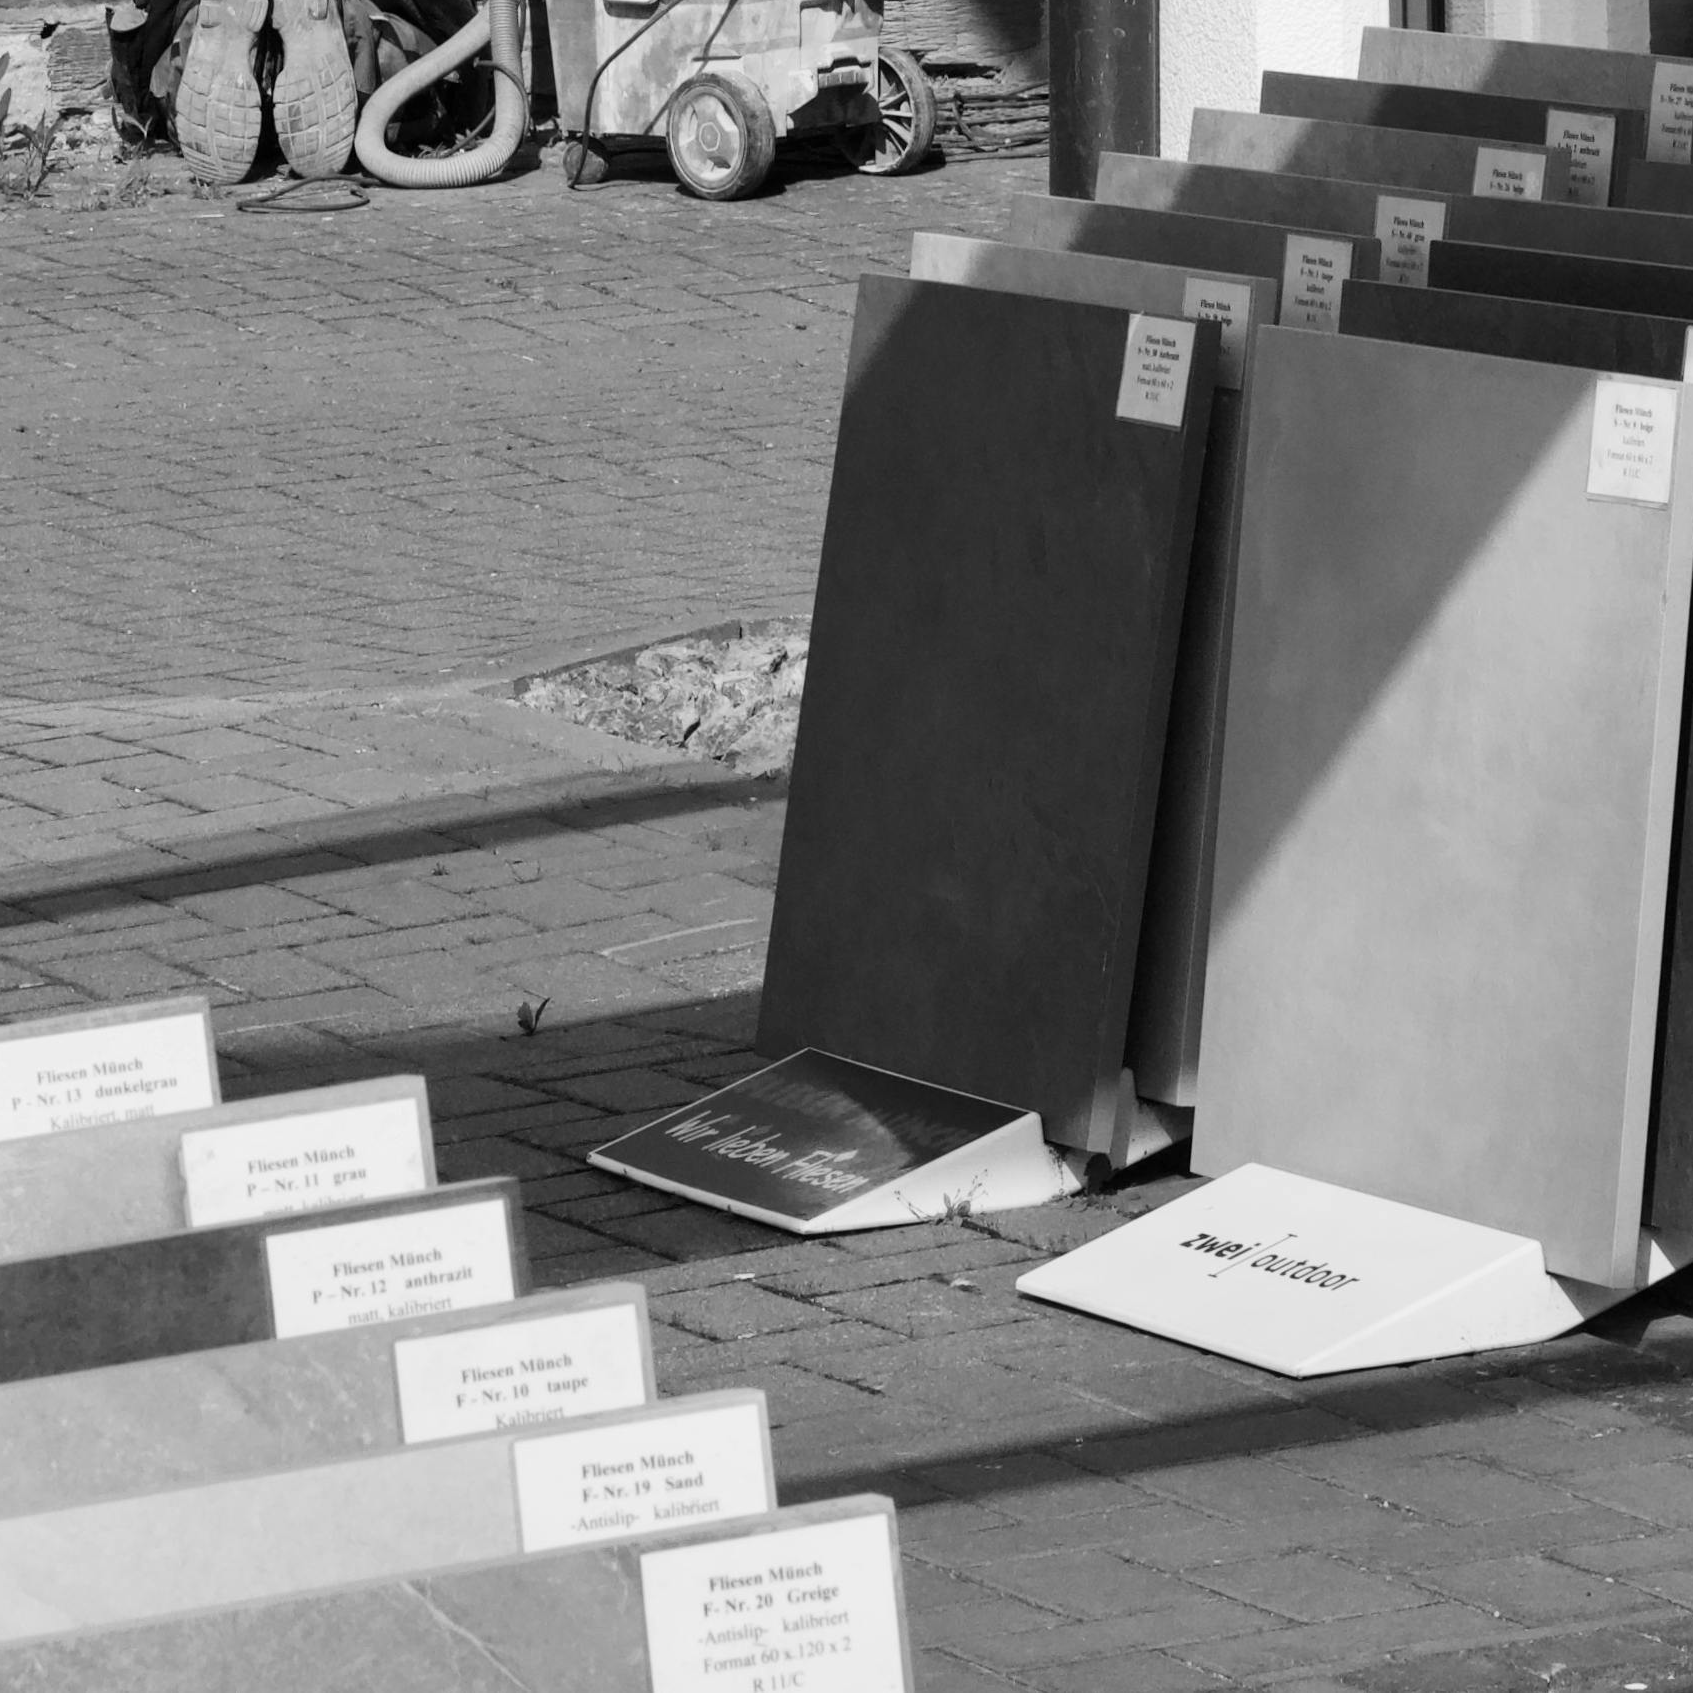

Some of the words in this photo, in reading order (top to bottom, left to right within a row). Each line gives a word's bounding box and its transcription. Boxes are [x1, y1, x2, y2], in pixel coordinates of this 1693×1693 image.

[36, 1069, 87, 1085] Fliesen
[93, 1057, 143, 1077] Münch
[12, 1097, 21, 1111] P
[37, 1093, 60, 1107] Nr.
[67, 1088, 82, 1102] 13
[95, 1077, 178, 1099] dunkelgrau
[247, 1156, 299, 1174] Fliesen
[304, 1145, 355, 1165] Münch
[701, 1125, 790, 1166] lieben
[771, 1149, 869, 1194] Fliesen
[247, 1183, 257, 1197] P
[274, 1178, 299, 1192] Nr.
[305, 1173, 319, 1187] 11
[333, 1168, 367, 1185] grau
[333, 1259, 384, 1278] Fliesen
[390, 1247, 443, 1267] Münch
[1179, 1233, 1262, 1260] zwei
[1250, 1254, 1360, 1291] outdoor
[312, 1290, 322, 1304] P
[341, 1284, 365, 1300] Nr.
[371, 1280, 387, 1295] 12
[405, 1266, 473, 1289] anthrazit
[388, 1296, 452, 1318] kalibriert
[461, 1365, 514, 1384] Fliesen
[519, 1352, 573, 1373] Münch
[456, 1393, 466, 1408] F
[482, 1388, 507, 1403] Nr.
[512, 1383, 529, 1399] 10
[546, 1376, 589, 1393] taupe
[581, 1461, 634, 1479] Fliesen
[640, 1450, 694, 1471] Münch
[603, 1484, 628, 1500] Nr.
[635, 1480, 651, 1496] 19
[664, 1471, 704, 1491] Sand
[653, 1498, 720, 1520] kalibriert
[708, 1574, 763, 1592] Fliesen
[768, 1561, 823, 1582] Münch
[725, 1598, 751, 1613] Nr.
[755, 1593, 773, 1609] 20
[786, 1584, 840, 1605] Greige
[782, 1610, 849, 1634] kalibriert
[703, 1654, 758, 1674] Format
[761, 1649, 779, 1664] 60
[798, 1641, 825, 1659] 120
[829, 1643, 838, 1653] x
[842, 1636, 852, 1652] 2
[752, 1678, 764, 1693] R
